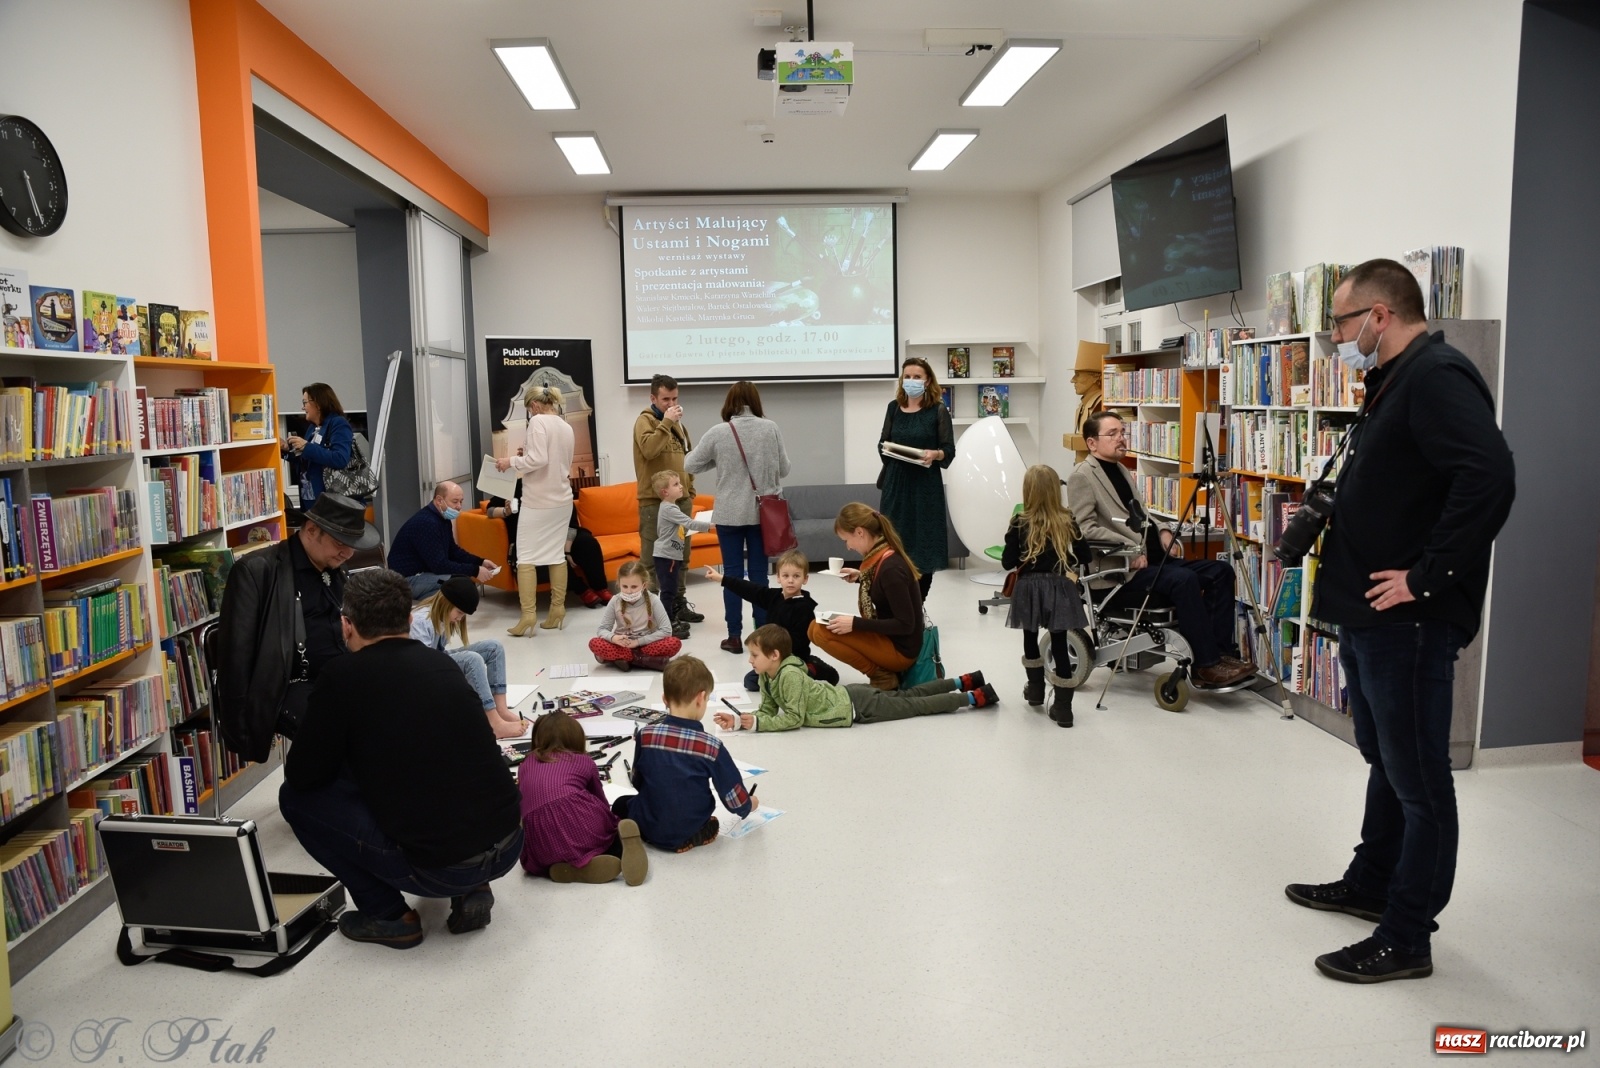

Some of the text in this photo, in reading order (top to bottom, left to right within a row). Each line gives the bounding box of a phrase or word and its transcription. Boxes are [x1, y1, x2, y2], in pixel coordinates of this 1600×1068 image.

[1, 129, 8, 140] 11
[15, 128, 22, 138] 12
[633, 216, 768, 234] Artyści Malujący
[632, 234, 770, 250] Ustami i Nogami
[658, 252, 746, 262] wernisaż wystawy
[634, 267, 688, 280] Spotkanie
[700, 266, 749, 278] artystami
[642, 280, 702, 294] prezentacja
[706, 278, 766, 290] malowania:
[708, 302, 730, 310] Bartek
[732, 312, 756, 320] Gruca
[686, 332, 839, 346] 2 lutego, godz. 17.00
[502, 348, 560, 358] Public Library
[639, 351, 673, 360] Galeria
[749, 348, 798, 357] biblioteki)
[816, 346, 873, 356] Kasprowicza
[504, 358, 540, 366] Raciborz
[137, 398, 147, 440] MANGA
[153, 494, 163, 533] KOMIKSY
[37, 502, 52, 563] ZWIERZĘTA
[183, 764, 195, 804] BAŚNIE
